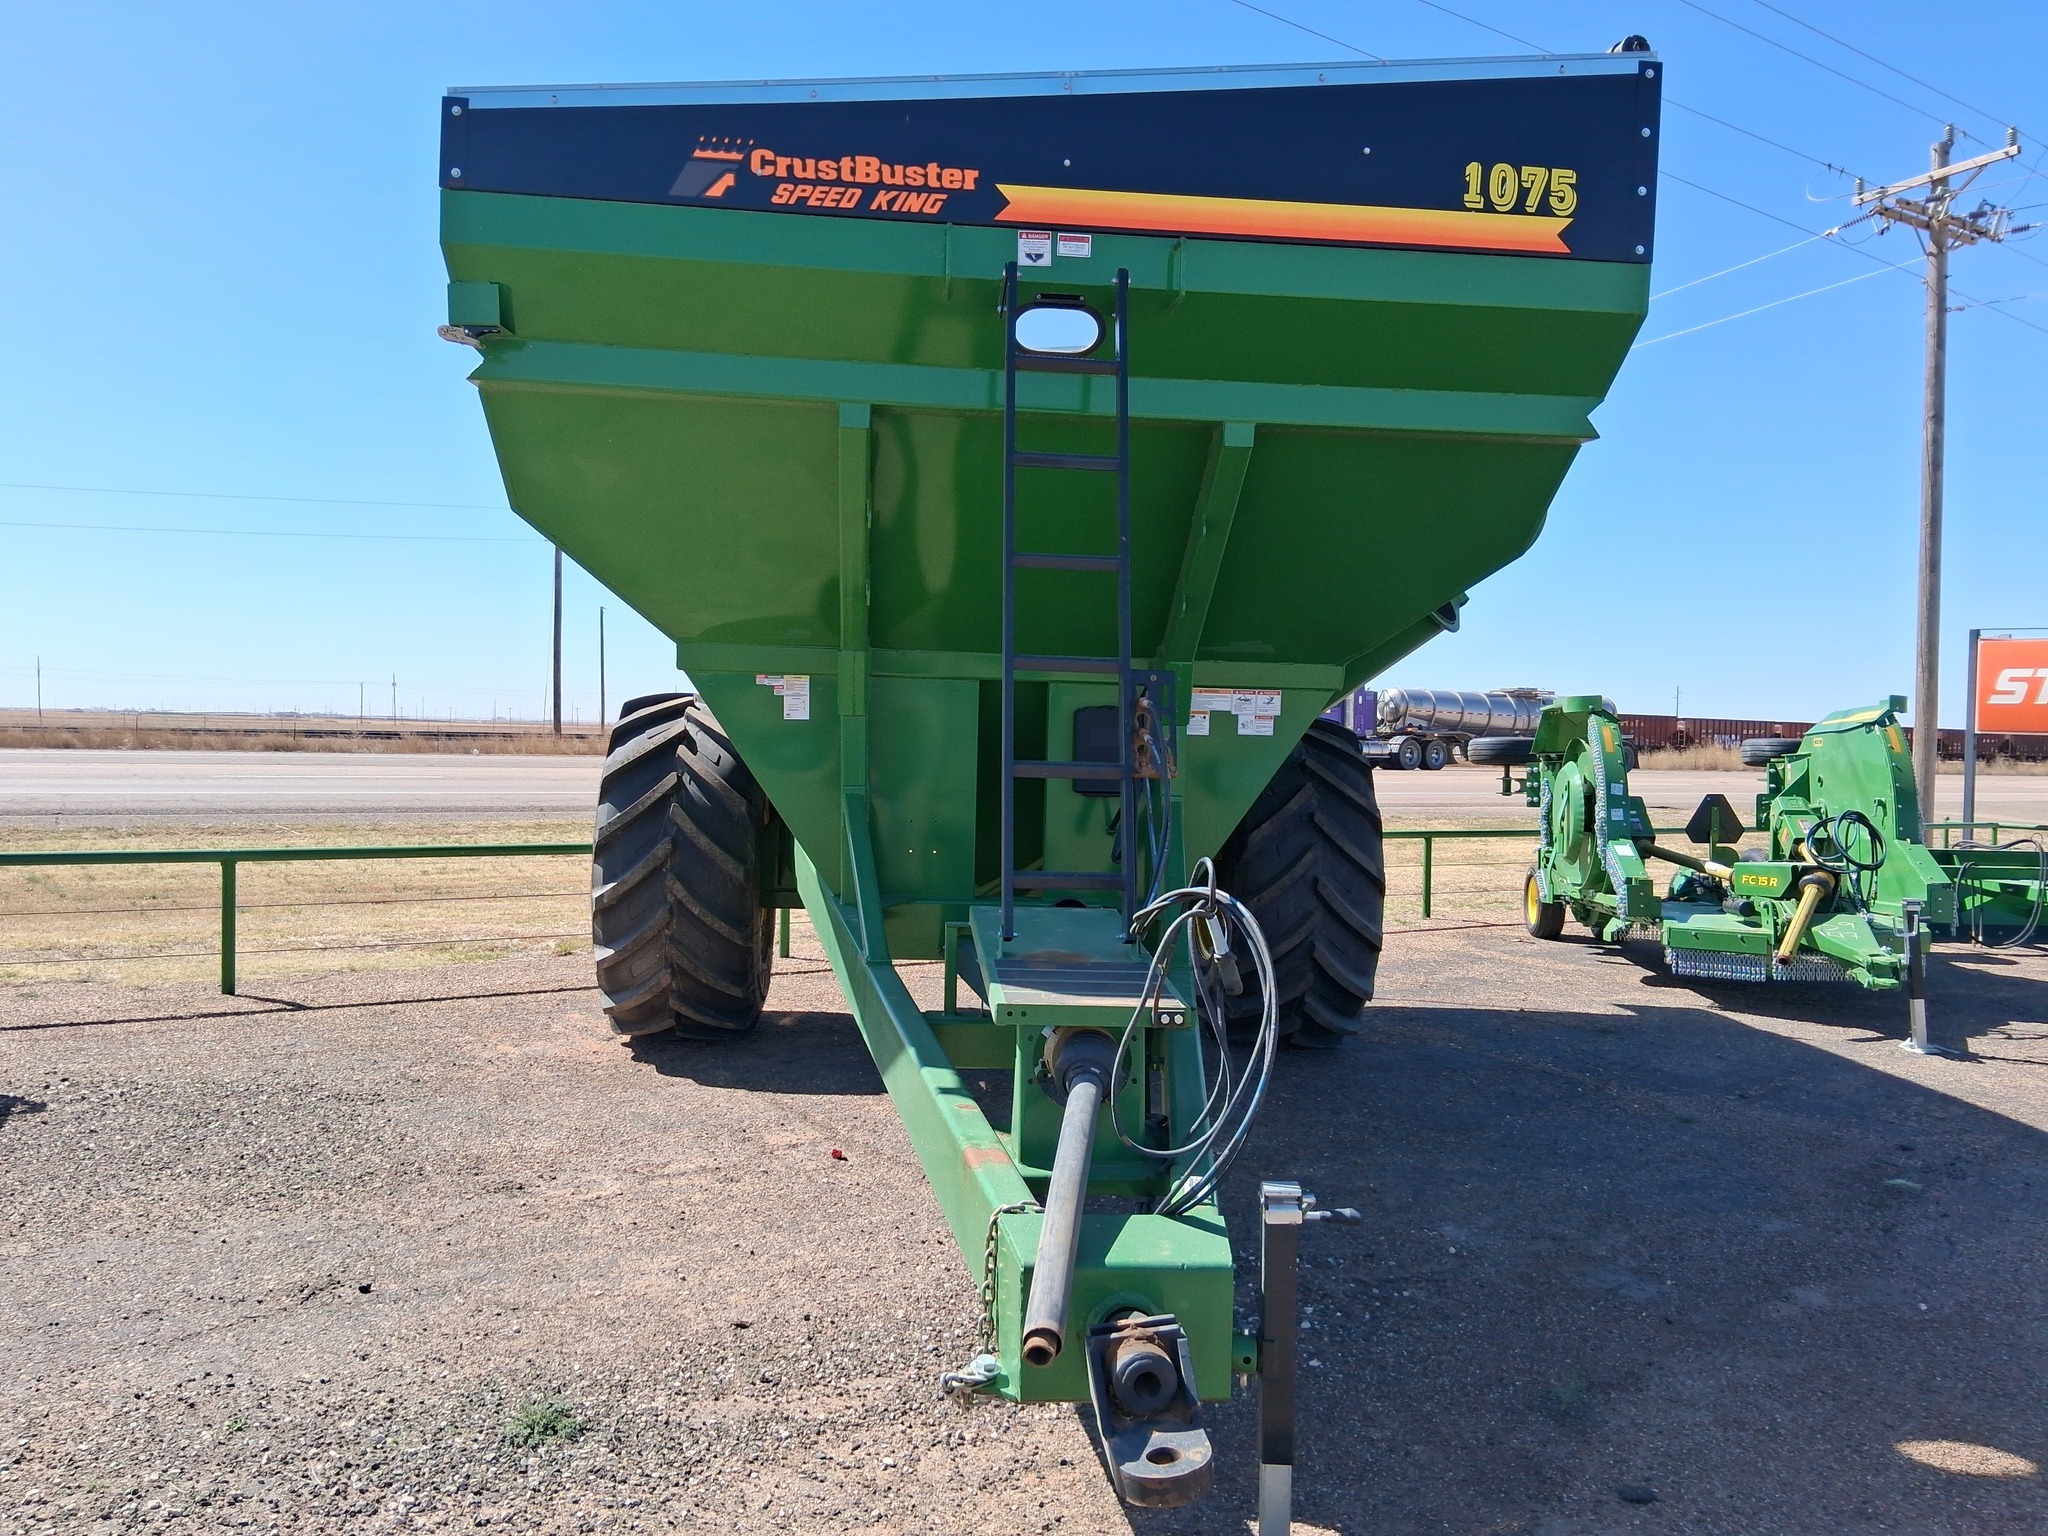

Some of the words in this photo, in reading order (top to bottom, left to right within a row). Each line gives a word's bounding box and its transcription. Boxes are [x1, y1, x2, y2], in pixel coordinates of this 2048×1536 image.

[750, 148, 979, 190] CrustBuster
[1463, 161, 1577, 216] 1075
[770, 183, 863, 209] SPEED
[869, 190, 948, 214] KING
